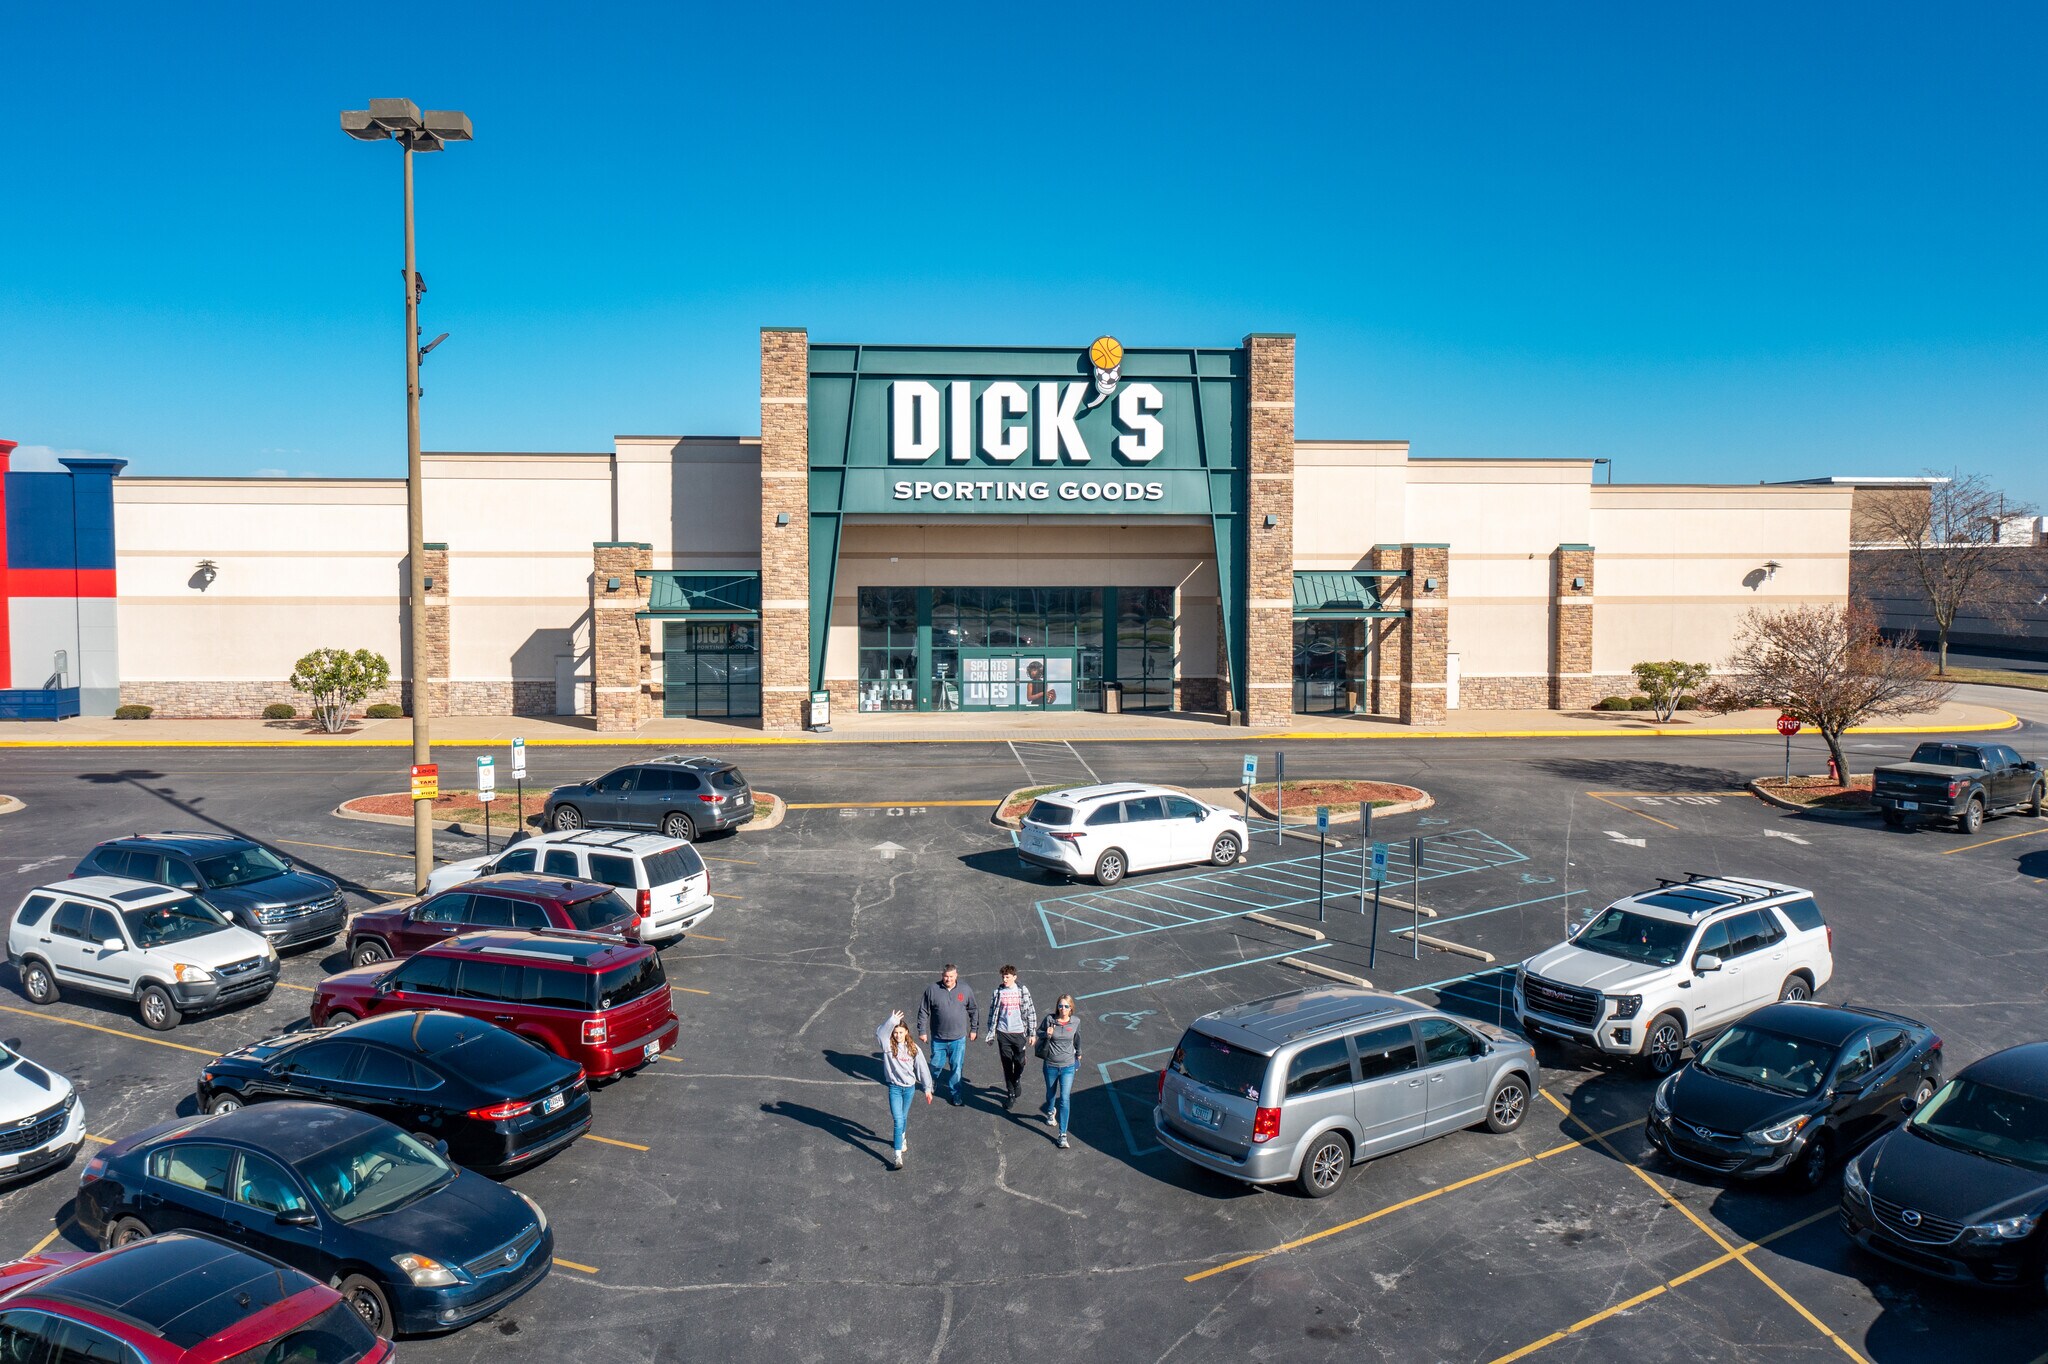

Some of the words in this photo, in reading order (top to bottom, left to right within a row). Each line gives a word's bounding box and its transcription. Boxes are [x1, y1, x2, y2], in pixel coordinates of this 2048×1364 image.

[893, 380, 1164, 461] DICK'S
[893, 481, 1049, 500] SPORTING
[1059, 482, 1164, 500] GOODS
[970, 660, 1008, 671] SPORTS
[970, 671, 1008, 682] CHANGE
[970, 682, 1008, 699] LIVES
[1778, 720, 1799, 729] STOP
[839, 807, 927, 817] STOP
[1541, 987, 1573, 1003] GMC
